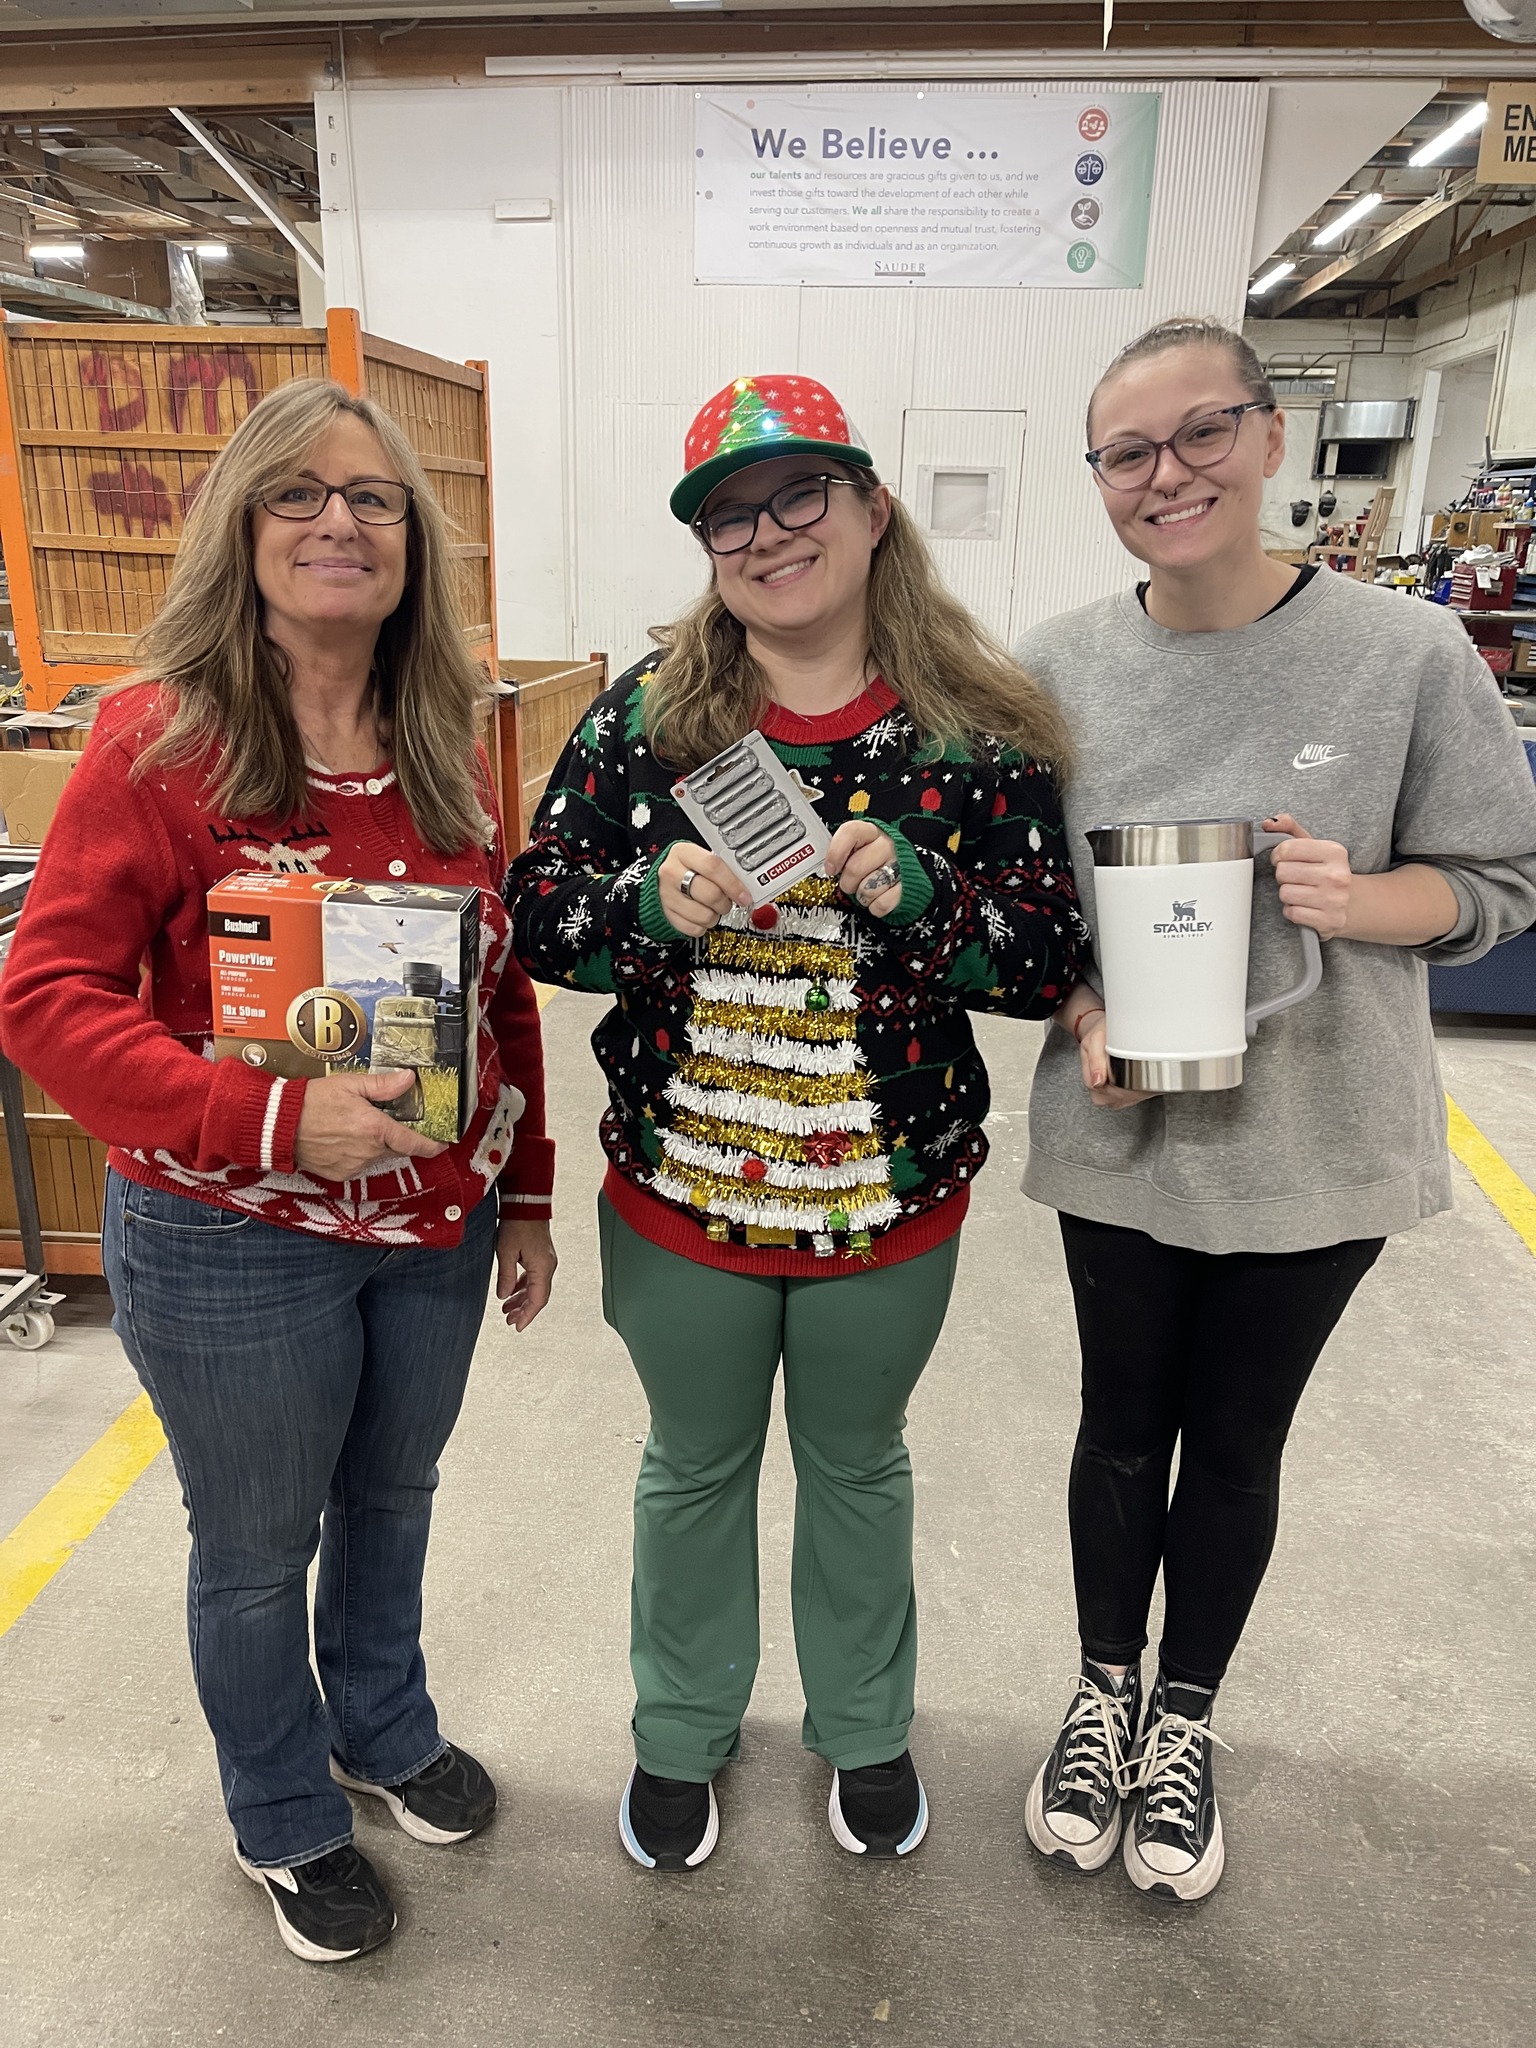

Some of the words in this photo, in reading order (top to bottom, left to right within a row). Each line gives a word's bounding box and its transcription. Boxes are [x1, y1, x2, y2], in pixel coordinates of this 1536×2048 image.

[751, 128, 806, 158] We
[822, 127, 951, 159] Believe
[750, 172, 765, 180] our
[769, 170, 801, 180] talents
[804, 171, 821, 180] and
[824, 172, 867, 180] resources
[870, 172, 883, 180] are
[886, 171, 925, 183] gracious
[928, 170, 947, 183] gifts
[950, 171, 974, 183] given
[978, 171, 987, 181] to
[990, 172, 1002, 182] us,
[1006, 171, 1023, 181] and
[1026, 173, 1039, 181] we
[750, 188, 778, 198] invest
[779, 188, 802, 198] those
[805, 187, 824, 199] gifts
[828, 188, 858, 198] toward
[861, 188, 875, 198] the
[878, 188, 939, 200] development
[941, 188, 951, 198] of
[953, 188, 975, 198] each
[978, 189, 1002, 198] other
[1005, 189, 1028, 199] while
[749, 205, 781, 216] serving
[784, 206, 798, 215] our
[801, 206, 849, 215] customers.
[852, 206, 869, 215] We
[871, 206, 882, 215] all
[884, 206, 908, 215] share
[911, 206, 926, 215] the
[928, 206, 988, 218] responsibility
[991, 207, 1000, 216] to
[1003, 207, 1031, 216] create
[1034, 208, 1040, 216] a
[749, 222, 770, 232] work
[772, 222, 828, 232] environment
[831, 222, 858, 232] based
[861, 224, 872, 233] on
[875, 224, 918, 234] openness
[921, 223, 938, 233] and
[941, 224, 972, 233] mutual
[975, 225, 997, 234] trust,
[1000, 224, 1041, 236] fostering
[749, 240, 797, 249] continuous
[800, 240, 831, 251] growth
[833, 241, 843, 250] as
[845, 240, 893, 250] individuals
[895, 241, 913, 250] and
[915, 242, 925, 250] as
[927, 242, 938, 250] an
[940, 242, 999, 253] organization.
[874, 261, 925, 272] SAUDER
[1300, 743, 1335, 760] NIKE
[769, 846, 813, 877] CHIPOTLE
[224, 919, 258, 933] Bushnell
[1153, 921, 1212, 933] STANLEY
[219, 950, 274, 967] PowerView
[222, 1004, 237, 1016] 10x
[239, 1005, 266, 1018] 50mm
[314, 998, 342, 1051] B
